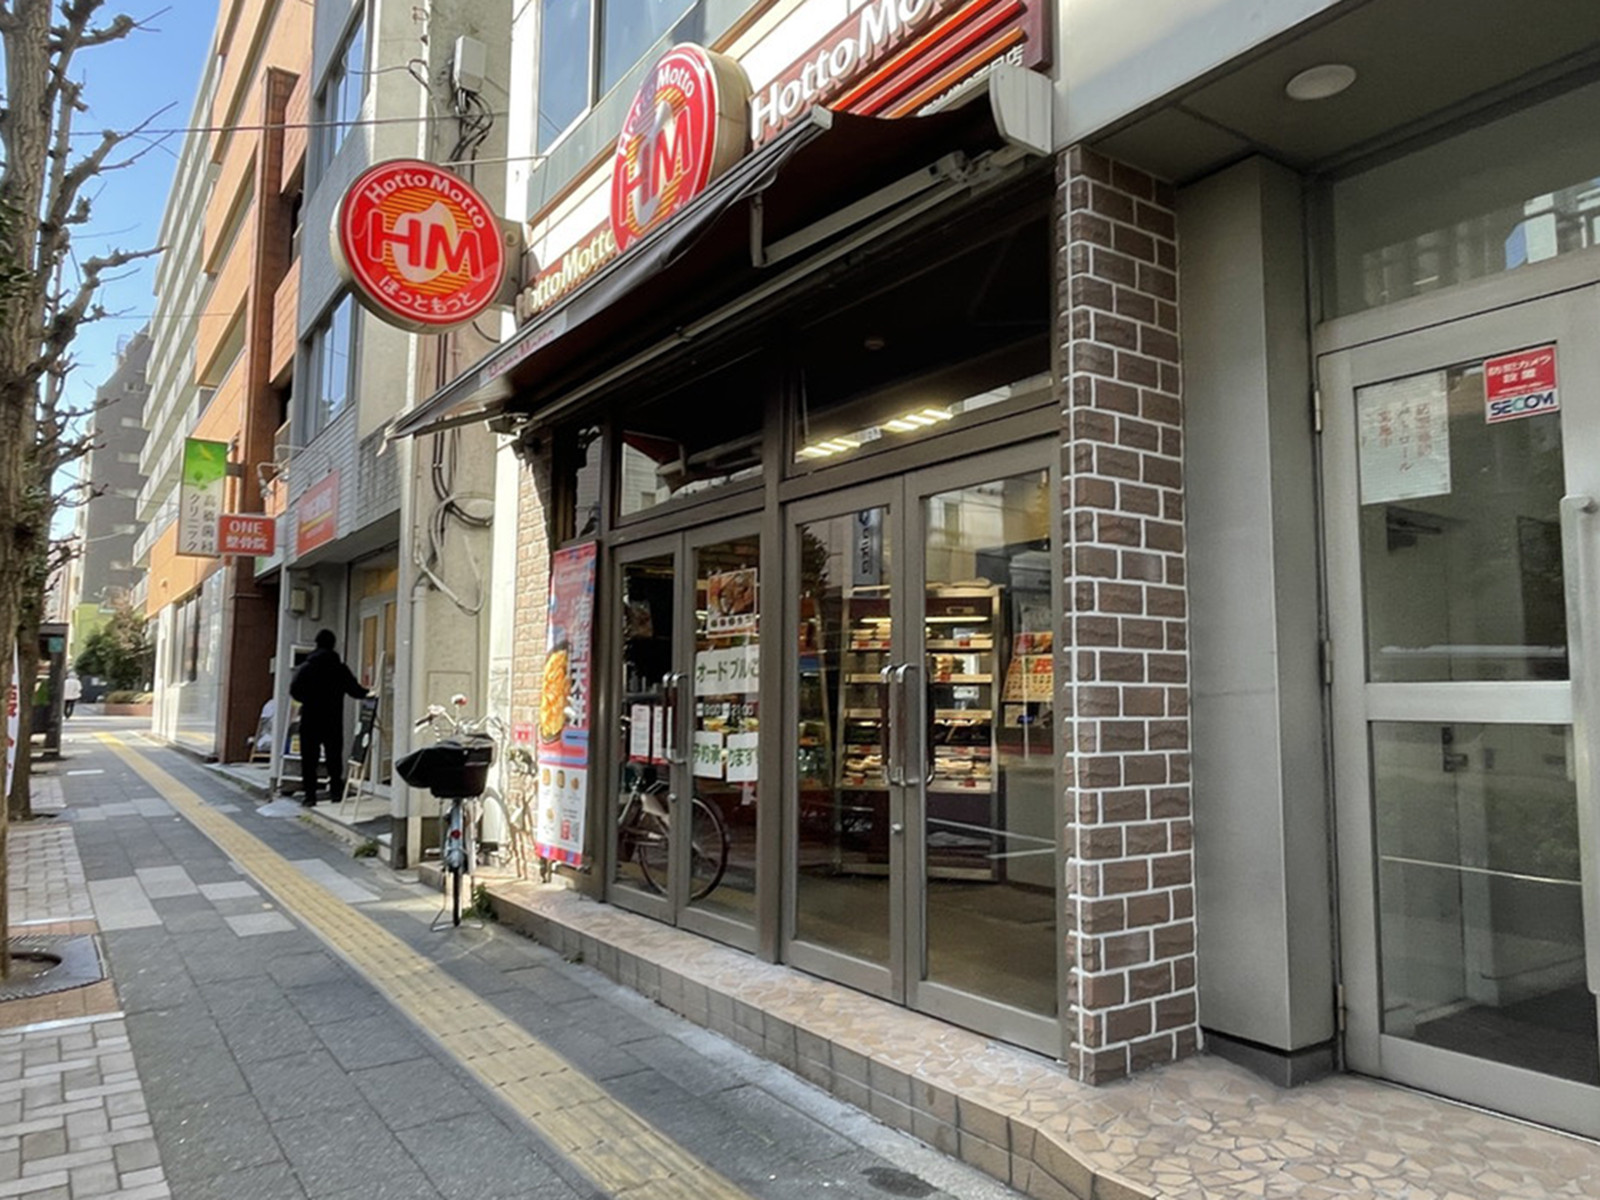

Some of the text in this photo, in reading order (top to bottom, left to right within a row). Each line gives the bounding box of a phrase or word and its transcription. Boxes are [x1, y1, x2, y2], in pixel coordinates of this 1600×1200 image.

[656, 64, 695, 98] Motto
[619, 106, 693, 227] HM
[363, 174, 486, 229] Hotto Motto
[367, 208, 484, 282] HM
[378, 274, 477, 314] ほっともっと
[1490, 391, 1554, 417] SECOM
[186, 493, 201, 553] クリニック
[229, 521, 263, 535] ONE
